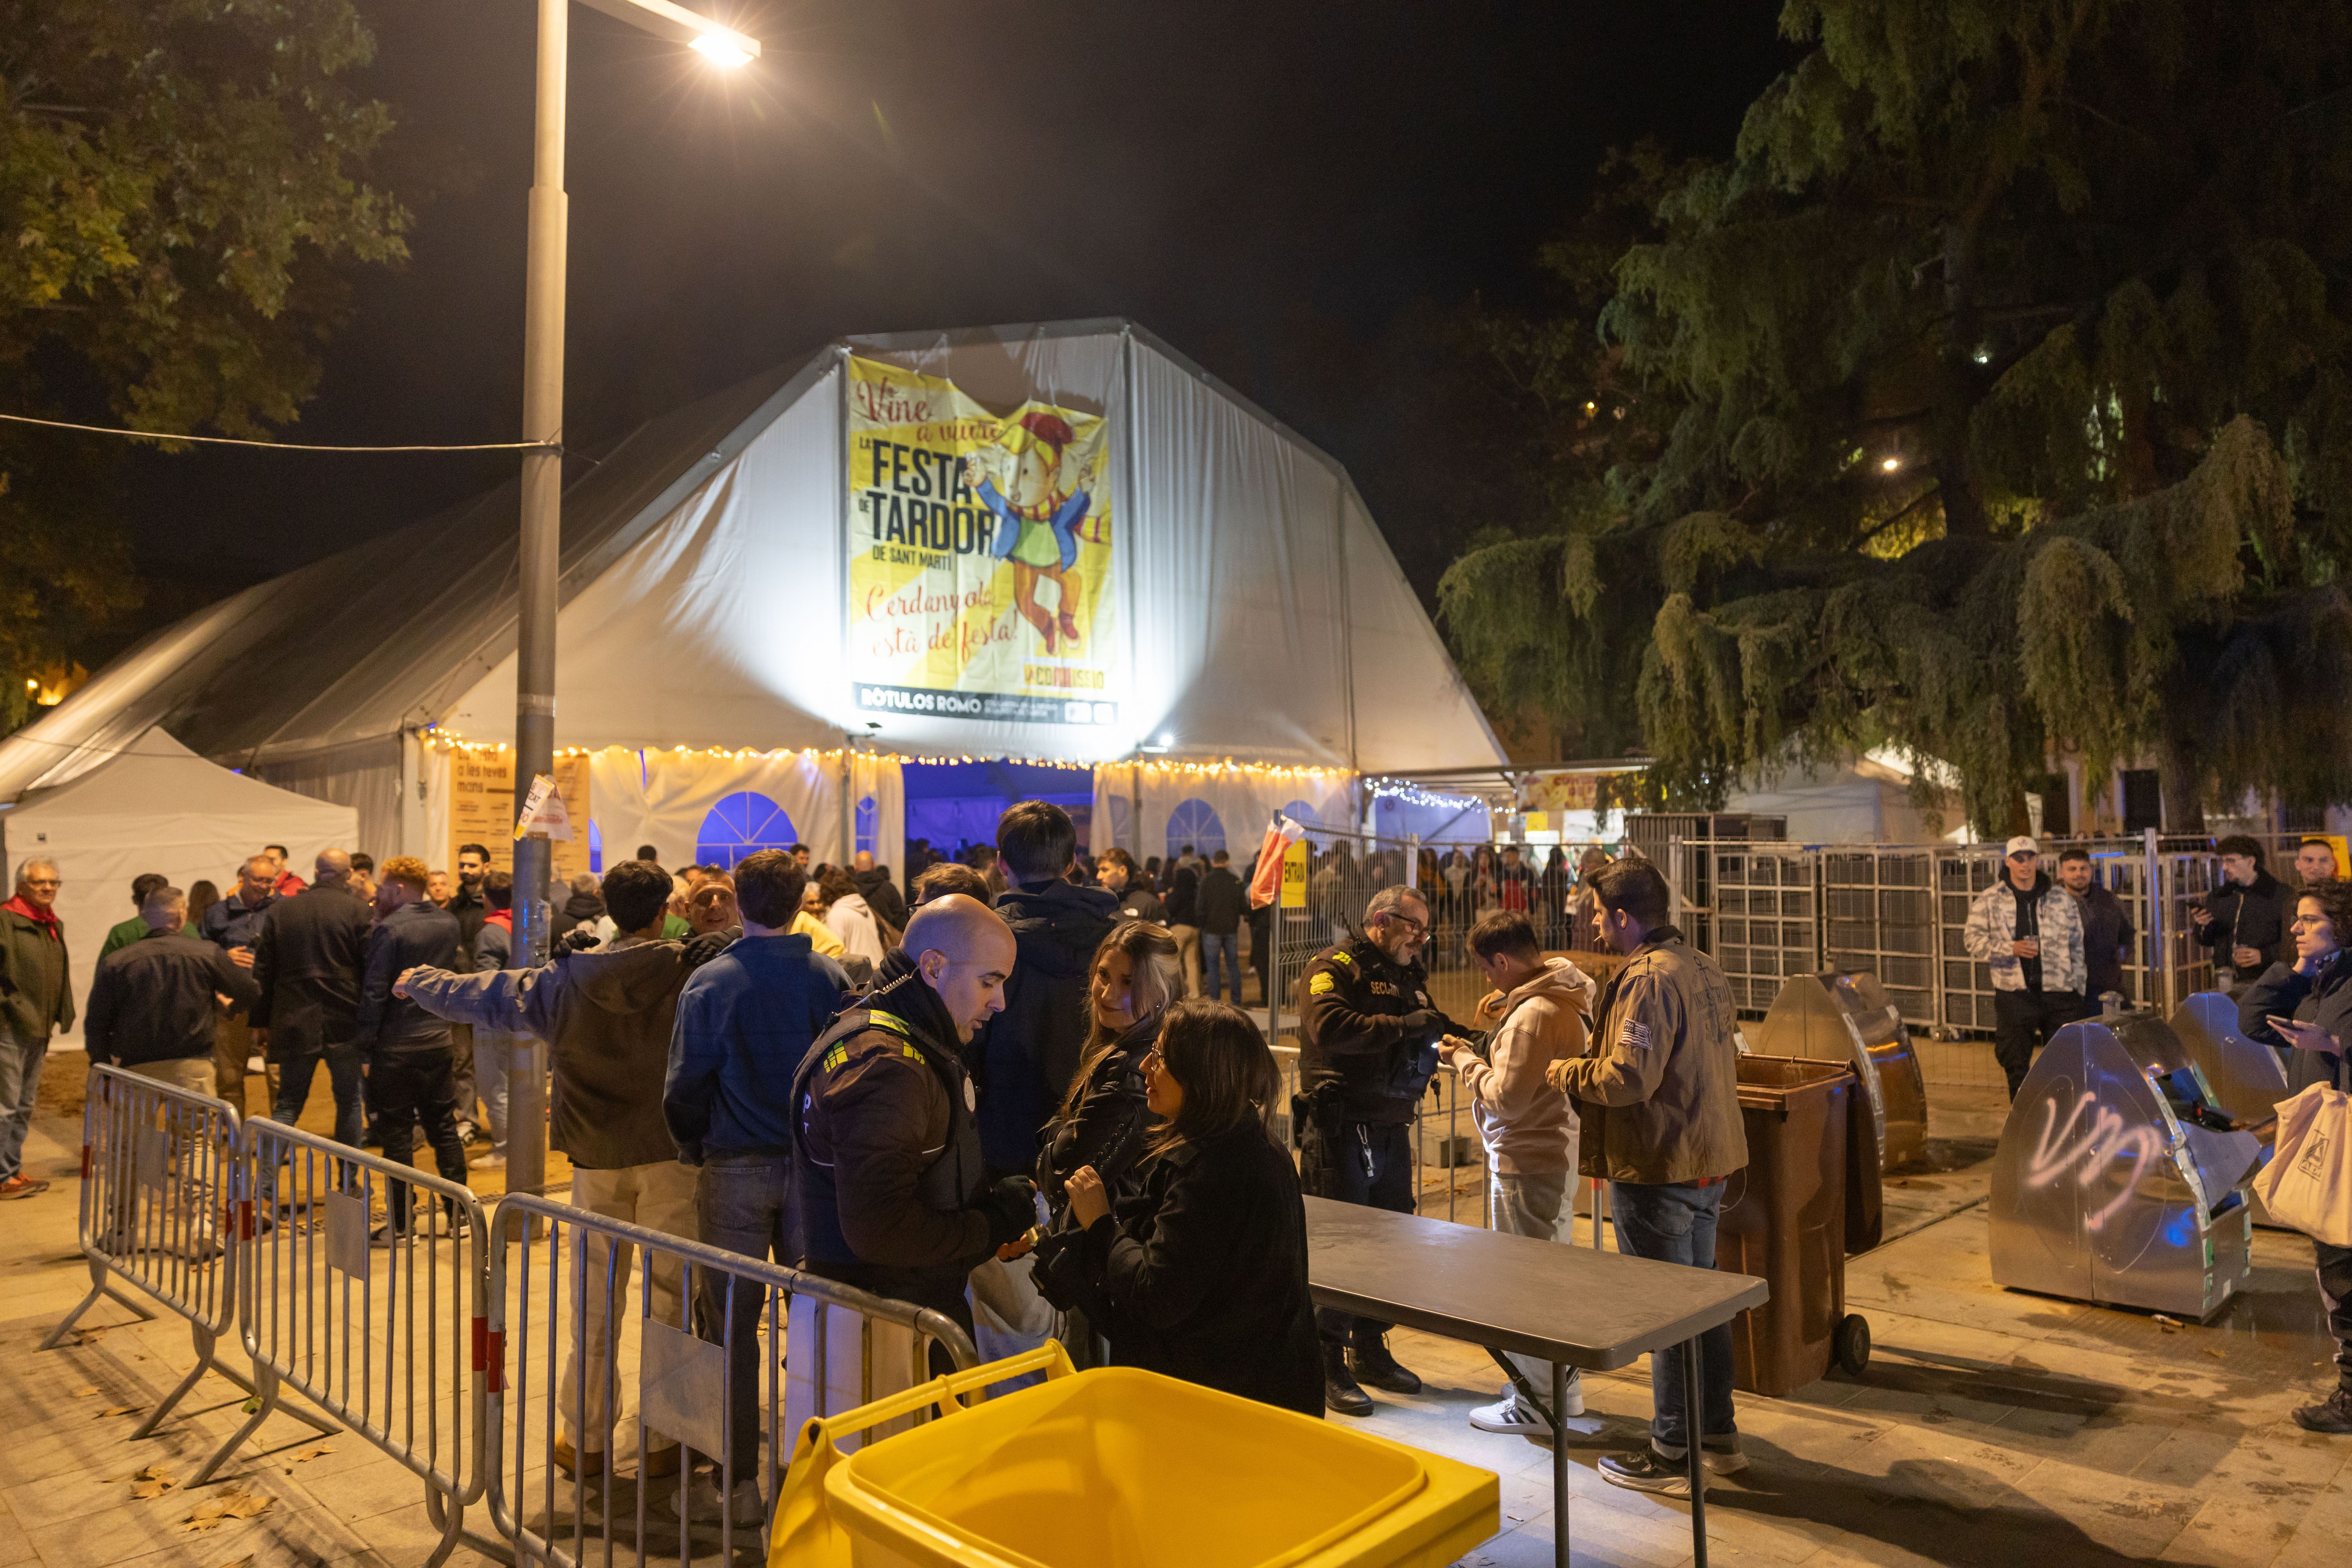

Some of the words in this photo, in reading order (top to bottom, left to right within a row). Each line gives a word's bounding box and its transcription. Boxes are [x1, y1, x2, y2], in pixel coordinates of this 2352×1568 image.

[857, 376, 930, 422] Vine
[860, 437, 870, 450] LA
[917, 425, 932, 441] a
[873, 439, 972, 504] FESTA
[859, 499, 869, 513] DE
[867, 491, 995, 557] TARDOR
[873, 545, 886, 561] DE
[890, 548, 916, 565] SANT
[866, 580, 994, 627] Cerdanyola
[928, 622, 953, 650] de
[962, 610, 1018, 663] festa!
[936, 695, 982, 713] ROMO
